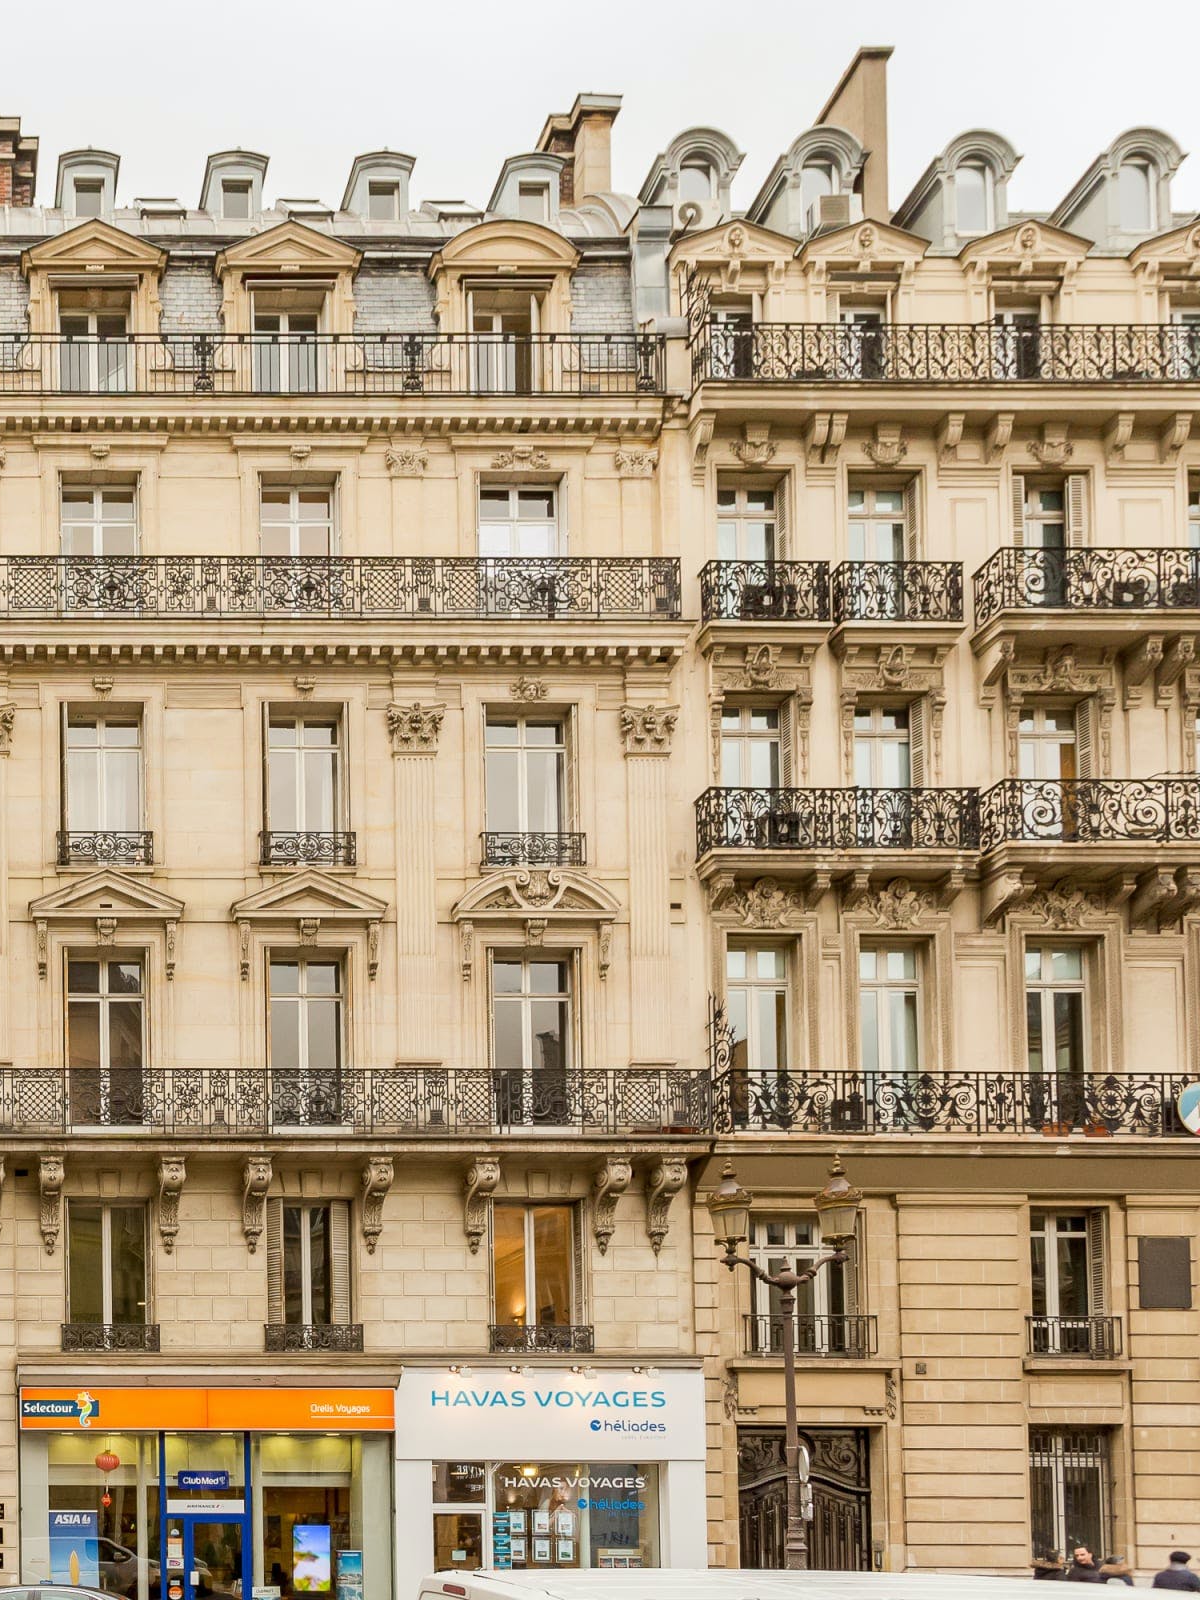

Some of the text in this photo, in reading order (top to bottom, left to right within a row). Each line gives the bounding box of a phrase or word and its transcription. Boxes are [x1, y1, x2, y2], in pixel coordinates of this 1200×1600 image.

[431, 1390, 666, 1407] HAVAS VOYAGES
[23, 1402, 74, 1413] Selectour
[335, 1403, 370, 1414] Voyages
[604, 1419, 666, 1432] héliades
[182, 1476, 219, 1485] Club Med
[504, 1477, 646, 1488] HAVAS VOYAGES
[590, 1498, 646, 1510] héliades
[54, 1514, 81, 1524] ASIA
